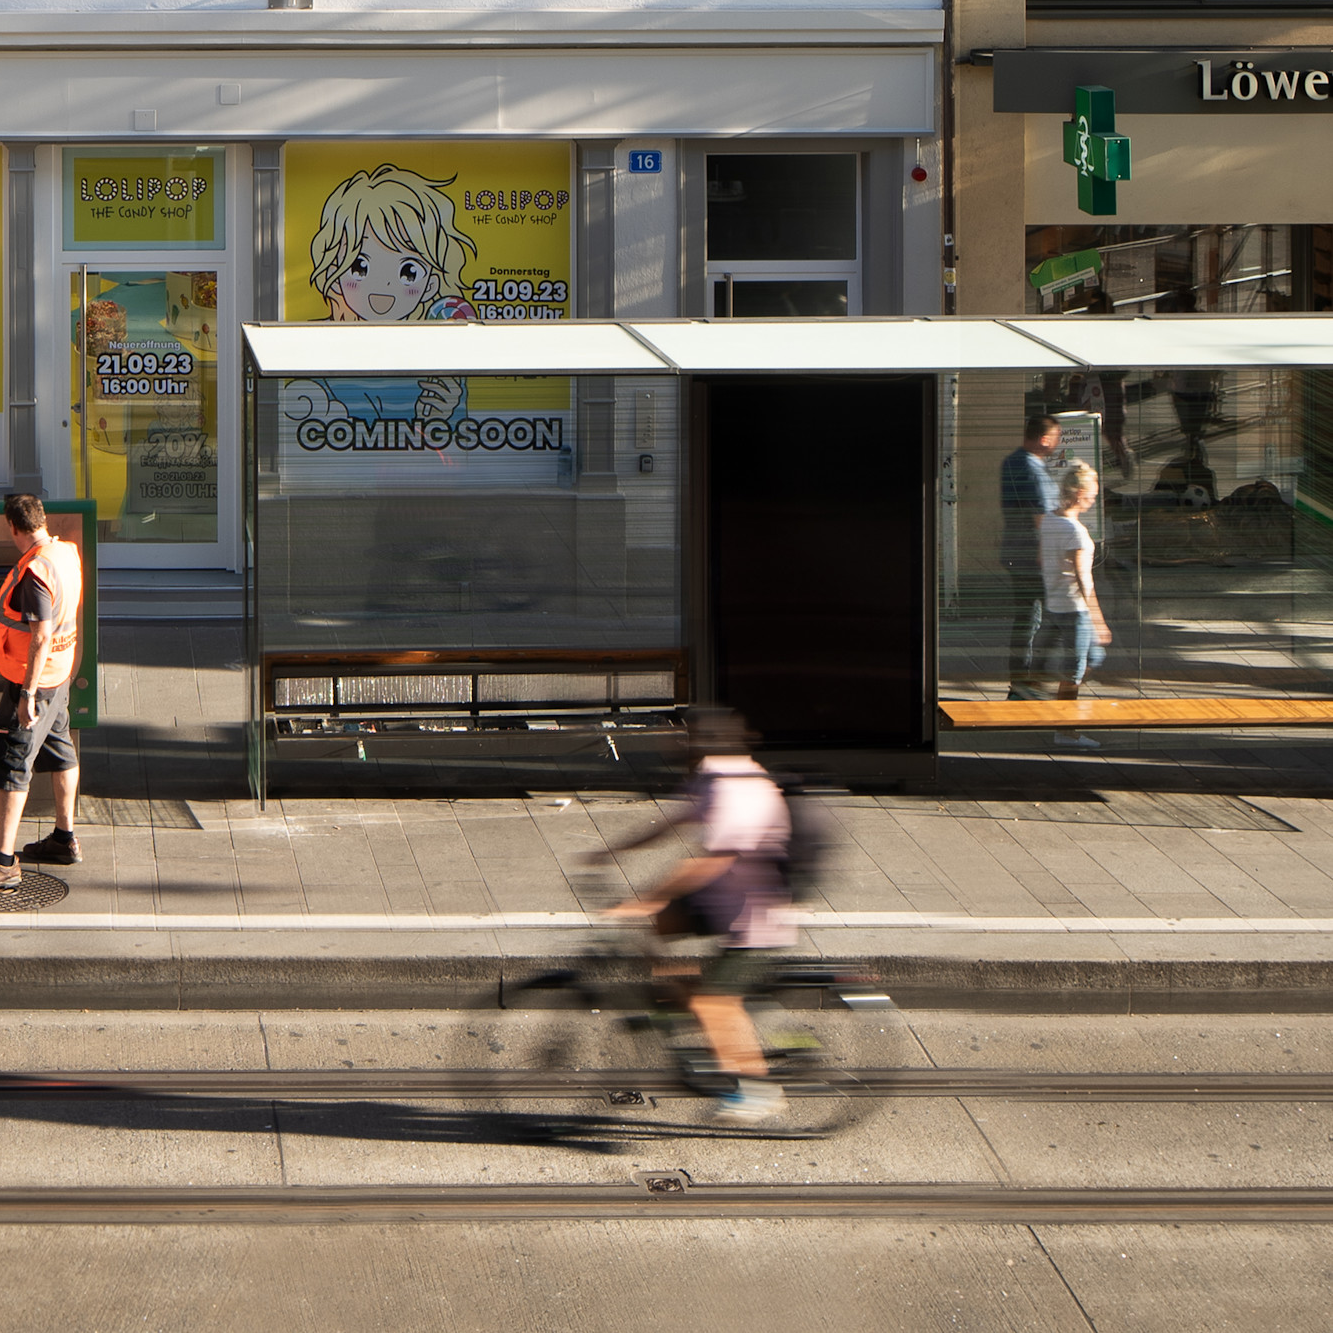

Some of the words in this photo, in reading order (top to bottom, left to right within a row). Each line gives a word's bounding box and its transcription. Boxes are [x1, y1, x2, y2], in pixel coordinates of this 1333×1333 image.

[1196, 59, 1333, 100] Löwe
[636, 154, 655, 170] 16
[80, 176, 208, 202] LOLIPOP
[464, 189, 570, 211] LOLIPOP
[90, 206, 115, 220] THE
[160, 204, 193, 220] SHOP
[473, 214, 492, 226] THE
[530, 212, 557, 226] SHOP
[489, 267, 550, 278] Donnerstag
[472, 278, 568, 302] 21.09.23
[477, 303, 527, 320] 16:00
[528, 304, 564, 320] Uhr
[108, 340, 181, 352] Neueröffnung
[97, 352, 194, 375] 21.09.23
[101, 377, 151, 395] 16:00
[152, 378, 188, 395] Uhr
[296, 417, 453, 451] COMING
[453, 417, 563, 451] SOON
[147, 432, 213, 458] 20%
[140, 482, 184, 498] 16:00
[185, 483, 218, 498] UHR
